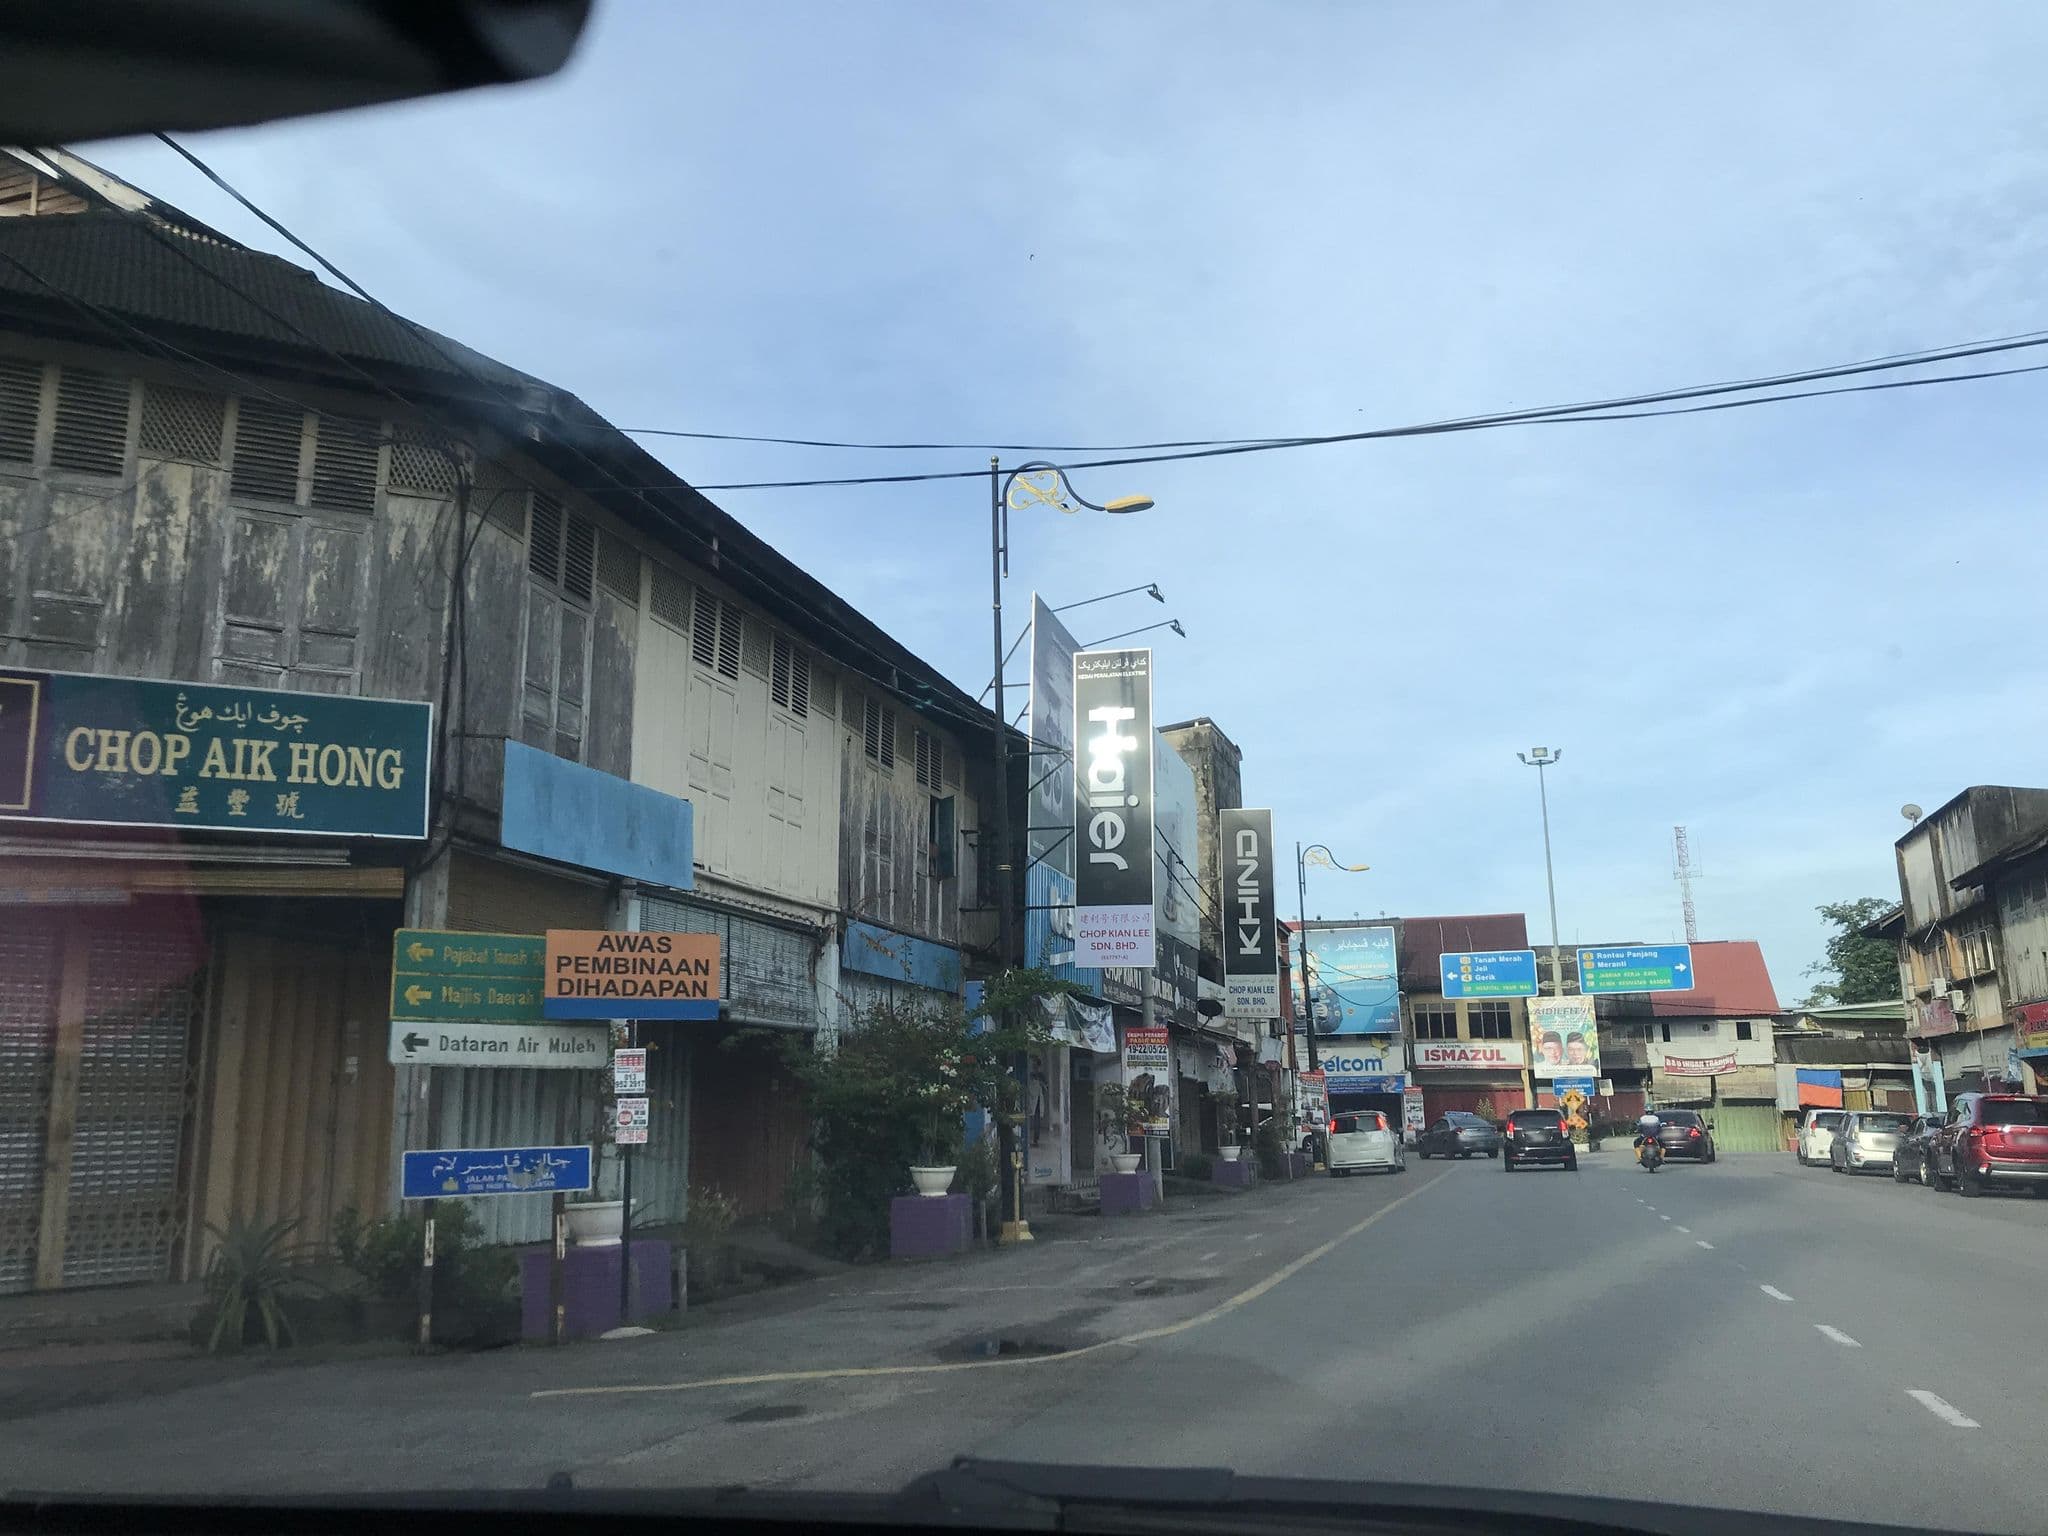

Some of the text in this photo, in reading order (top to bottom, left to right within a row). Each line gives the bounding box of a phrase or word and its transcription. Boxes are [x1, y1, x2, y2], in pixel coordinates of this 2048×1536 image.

[65, 726, 404, 789] CHOP AIK HONG
[1088, 706, 1139, 871] Haier
[1236, 829, 1262, 955] KHIND
[1080, 928, 1150, 939] CHOP KIAN LEE
[597, 934, 672, 954] AWAS
[1090, 941, 1139, 951] SDN. BHD.
[1626, 951, 1658, 959] Panjang
[556, 955, 710, 976] PEMBINAAN
[557, 978, 708, 998] DIHADAPAN
[1229, 985, 1275, 994] CHOP KIAN LEE
[439, 1034, 596, 1054] Dataran Air Muleh
[1424, 1049, 1506, 1062] ISMAZUL
